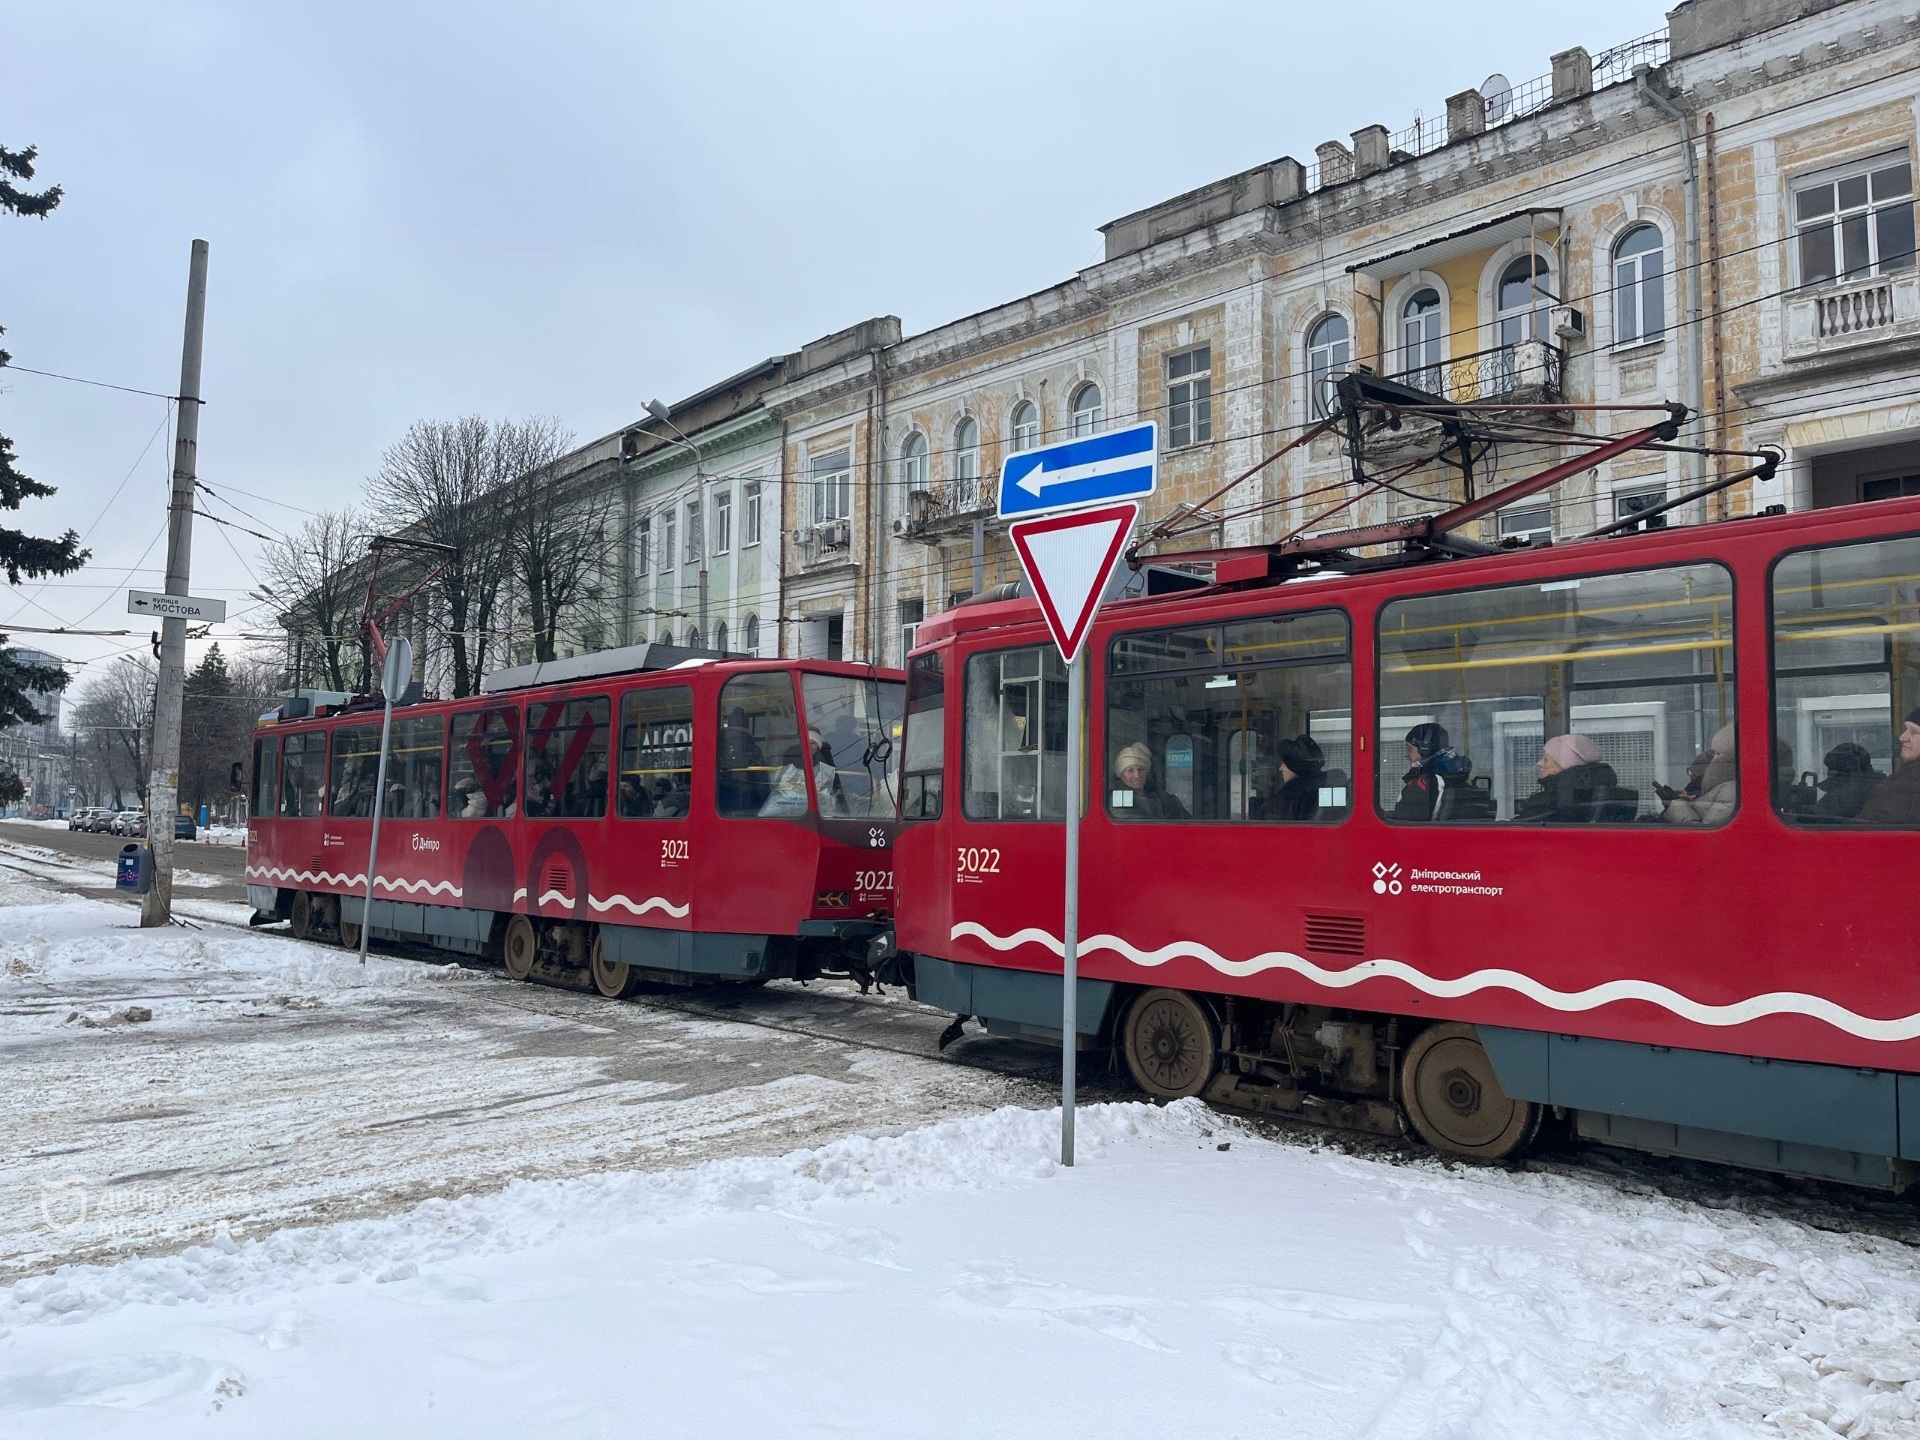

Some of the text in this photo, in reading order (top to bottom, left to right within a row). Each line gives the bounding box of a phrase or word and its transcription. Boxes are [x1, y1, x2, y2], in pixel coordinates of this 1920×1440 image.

[153, 604, 201, 615] МОСТОВА
[419, 837, 440, 852] Дніпро
[661, 839, 689, 859] 3021
[957, 848, 1000, 873] 3022
[854, 871, 894, 890] 3021
[1410, 869, 1481, 880] Дніпровський
[1411, 885, 1503, 896] електротранспорт
